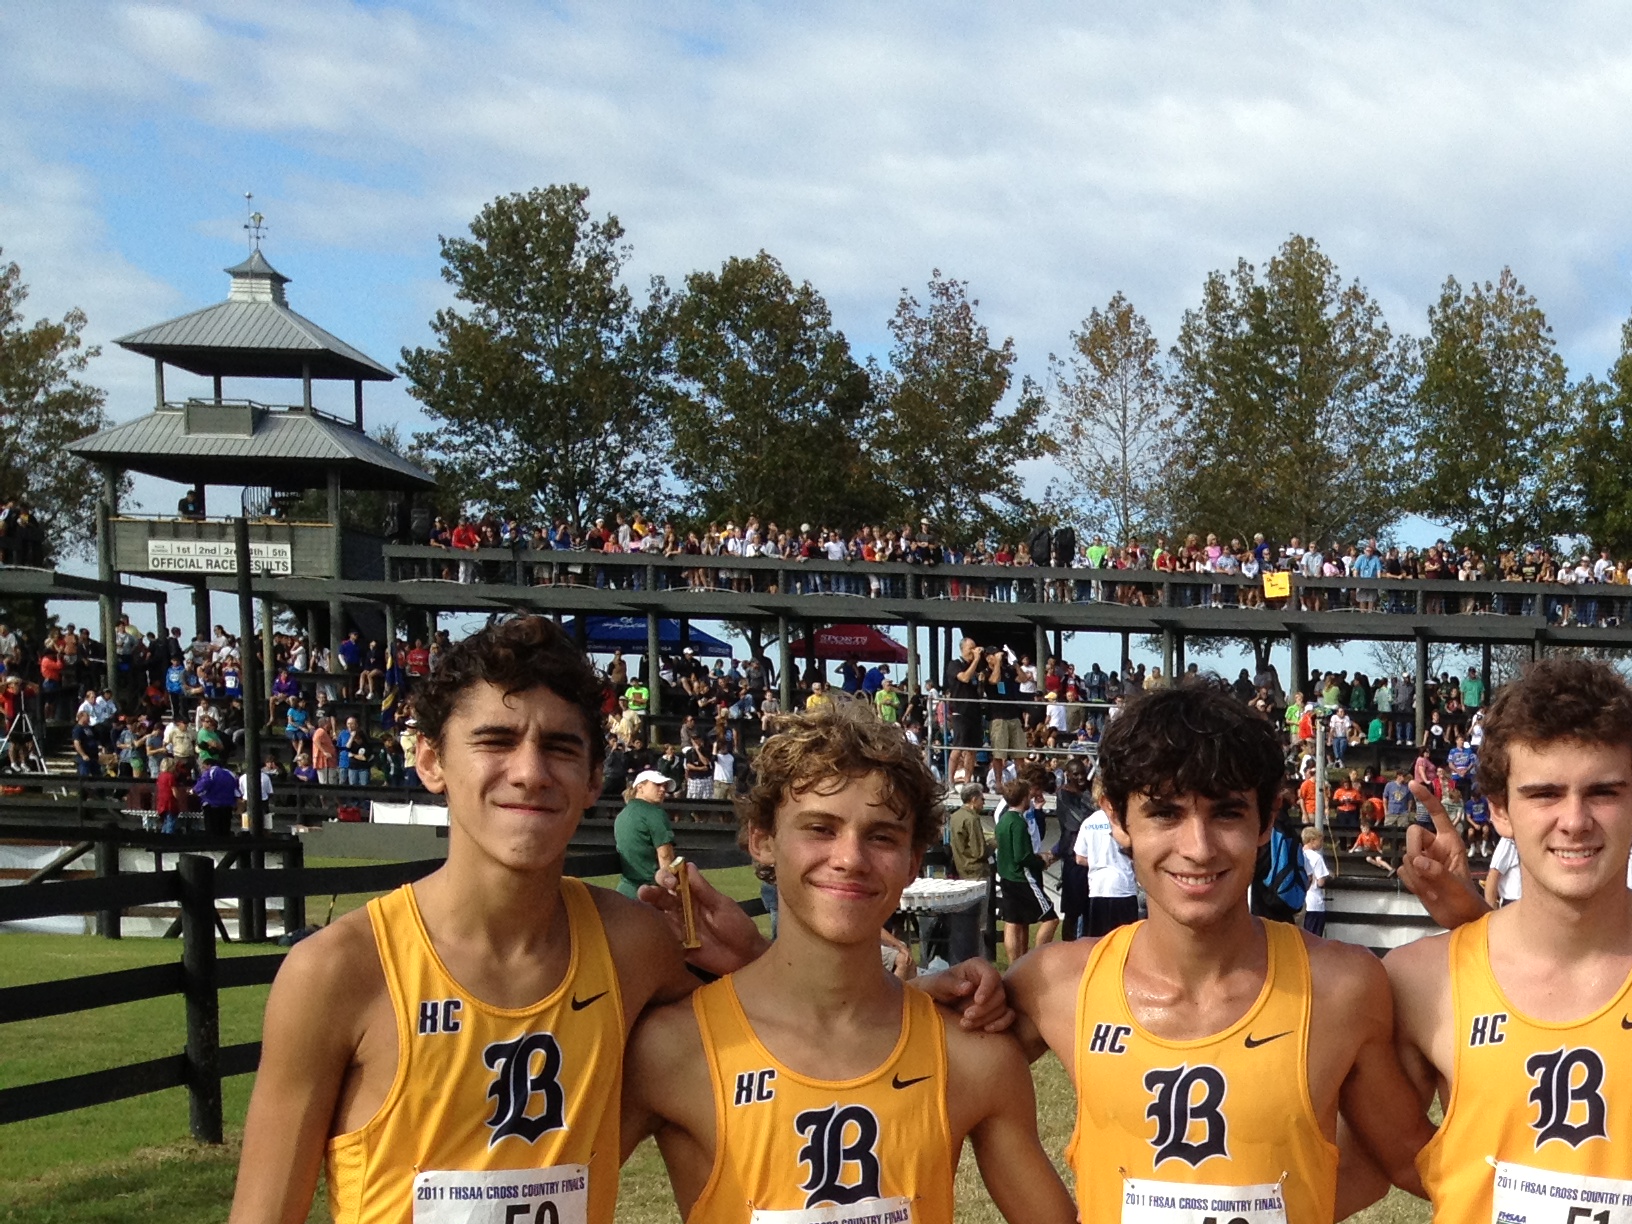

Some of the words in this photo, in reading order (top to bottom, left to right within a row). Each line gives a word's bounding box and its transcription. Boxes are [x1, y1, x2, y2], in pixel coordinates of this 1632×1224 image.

[177, 546, 190, 554] 1st
[199, 546, 216, 555] 2nd
[272, 548, 287, 556] 5th
[152, 557, 203, 569] OFFICIAL
[206, 558, 236, 570] RACE
[249, 560, 289, 572] ESULTS
[482, 1030, 569, 1154] B
[1525, 1044, 1611, 1153] B
[1142, 1061, 1232, 1173] B
[795, 1101, 882, 1209] B
[417, 1187, 444, 1200] 2011
[450, 1186, 482, 1200] FHSAA
[486, 1185, 518, 1199] CROSS
[522, 1182, 559, 1197] COUNTRY
[561, 1177, 585, 1193] FINALS
[1498, 1176, 1517, 1190] 2011
[1521, 1181, 1547, 1196] FHSAA
[1550, 1186, 1578, 1201] CROSS
[1581, 1190, 1620, 1206] COUNTRY
[1126, 1193, 1145, 1206] 2011
[1149, 1195, 1176, 1209] FHSAA
[1179, 1198, 1208, 1211] CROSS
[1211, 1199, 1252, 1212] COUNTRY
[1254, 1197, 1282, 1211] FINALS
[884, 1208, 908, 1224] FINALS
[1499, 1211, 1526, 1223] FHSAA
